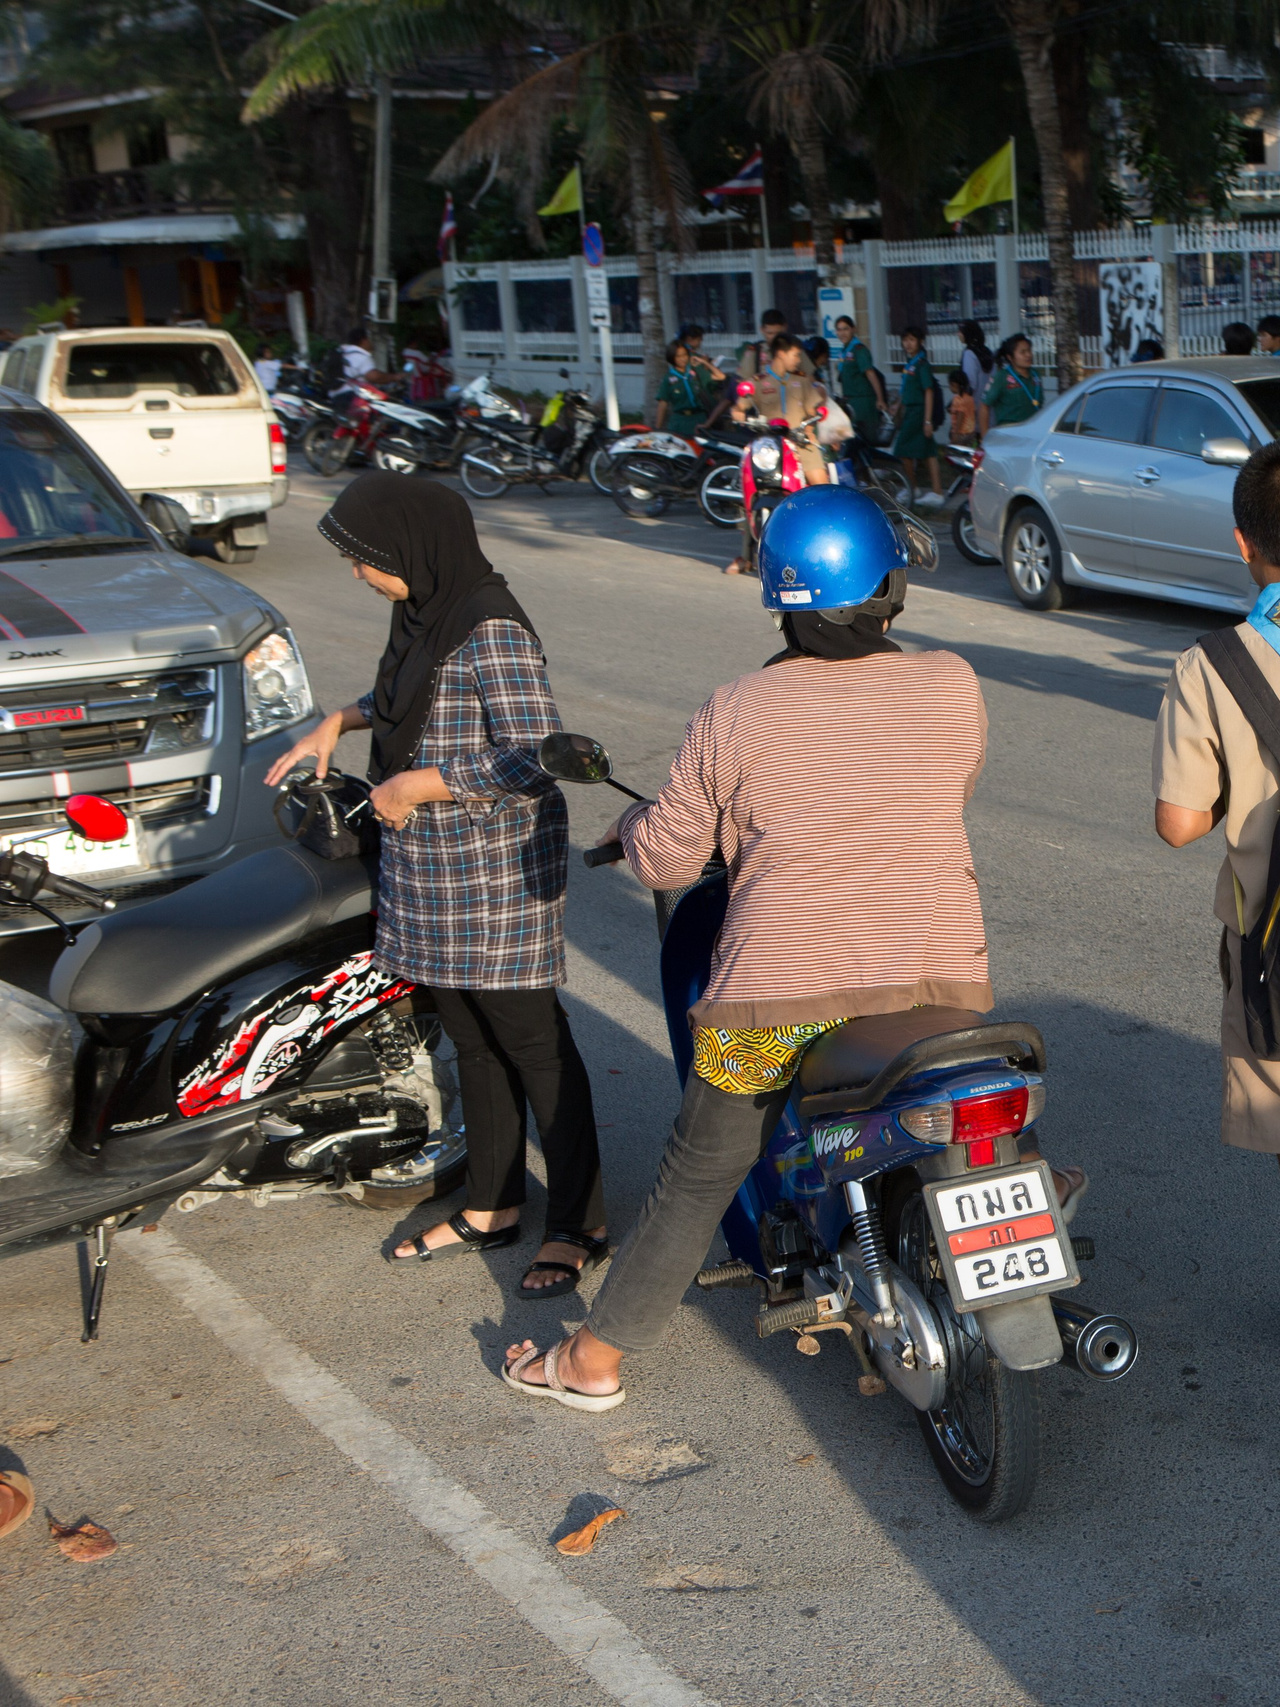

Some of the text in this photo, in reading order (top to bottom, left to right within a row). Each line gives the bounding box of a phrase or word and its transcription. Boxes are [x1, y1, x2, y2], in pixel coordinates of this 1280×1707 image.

[13, 706, 84, 728] ISUZU
[969, 1080, 1013, 1094] HONDA
[379, 1135, 422, 1149] HONDA
[813, 1126, 861, 1158] Wave
[844, 1145, 865, 1163] 110
[955, 1180, 1034, 1223] กมล
[972, 1246, 1051, 1291] 248
